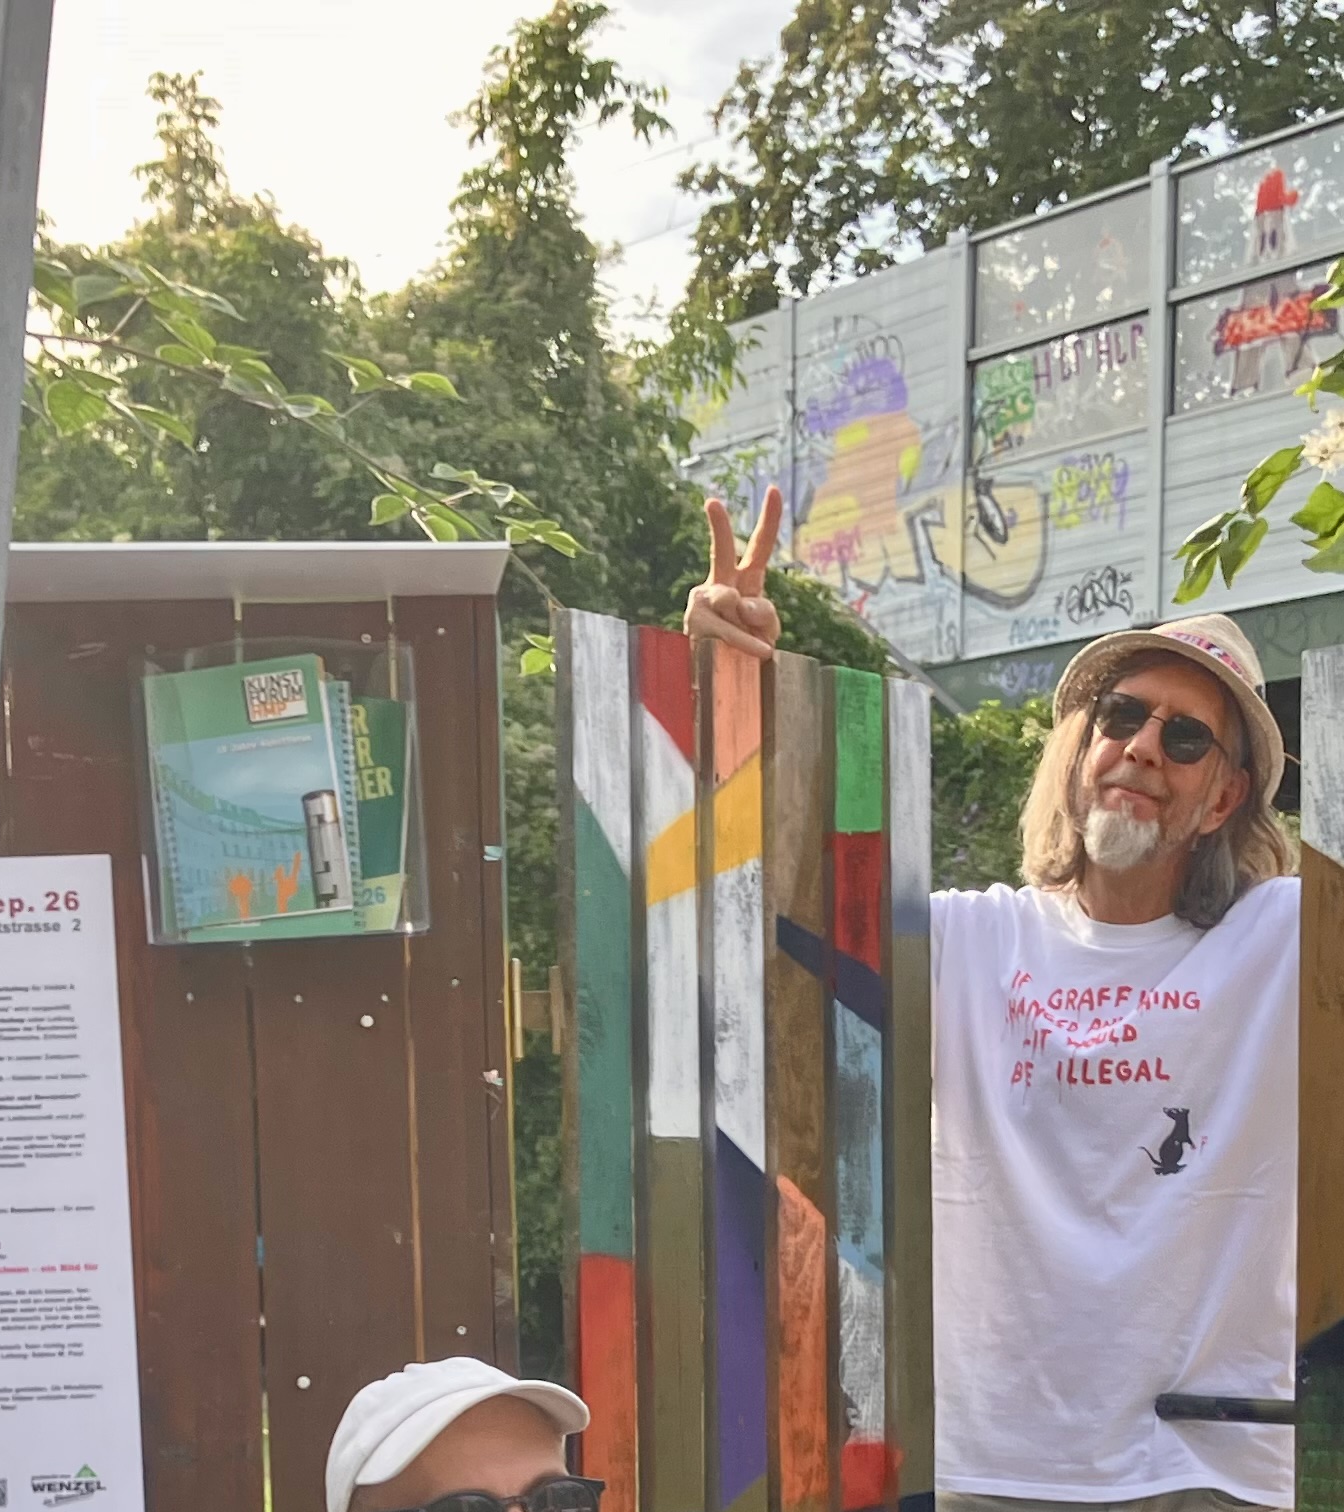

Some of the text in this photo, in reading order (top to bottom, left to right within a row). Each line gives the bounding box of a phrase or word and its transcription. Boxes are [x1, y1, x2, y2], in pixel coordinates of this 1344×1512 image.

[44, 890, 81, 912] 26
[71, 918, 82, 932] 2
[1048, 985, 1133, 1011] GRAFF
[1011, 1056, 1171, 1088] BE ILLEGAL
[32, 1480, 107, 1493] WENZEL
